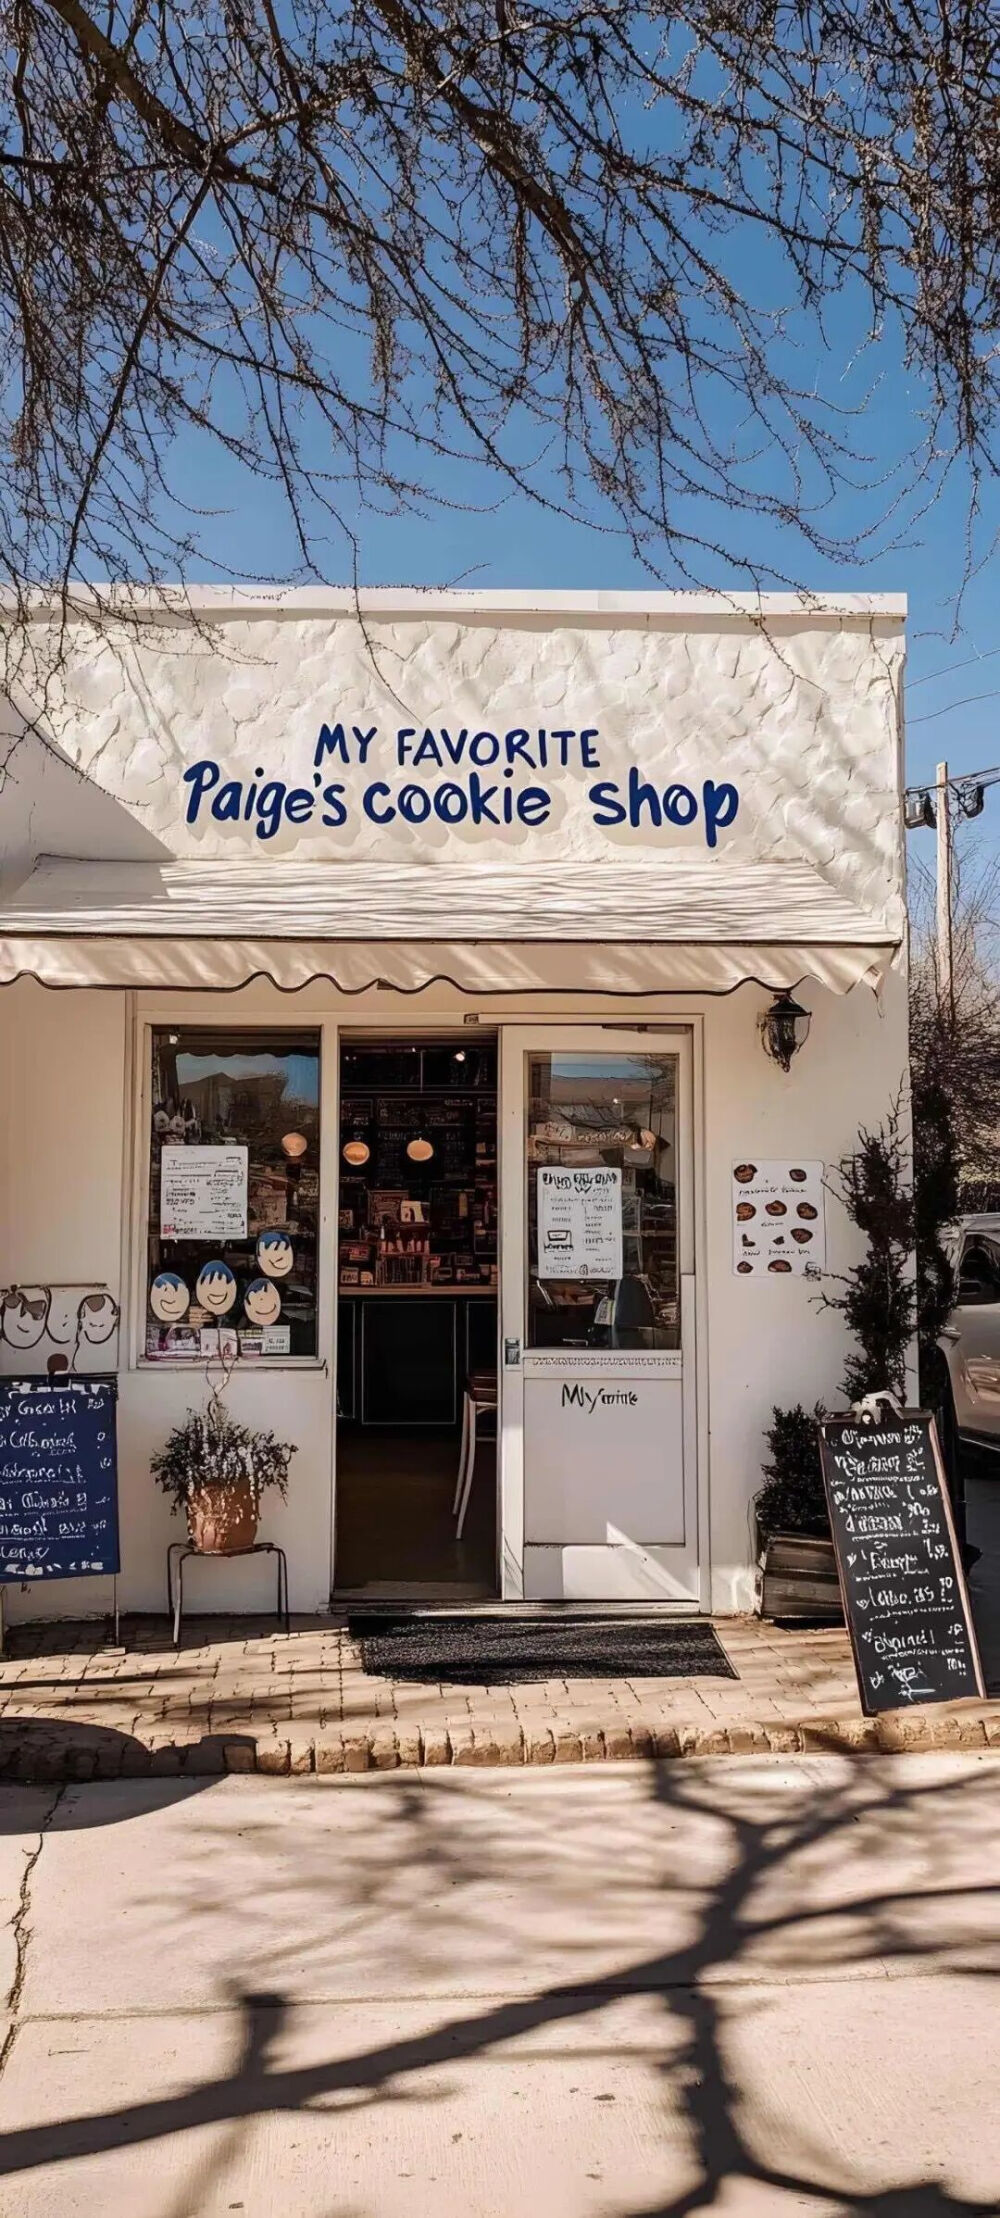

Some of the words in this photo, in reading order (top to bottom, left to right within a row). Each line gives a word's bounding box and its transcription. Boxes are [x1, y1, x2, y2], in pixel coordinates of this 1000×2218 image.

[314, 723, 377, 766] MY
[398, 728, 600, 768] FAVORITE
[184, 760, 348, 840] Paige's
[363, 768, 551, 826] cookie
[590, 767, 739, 847] shop
